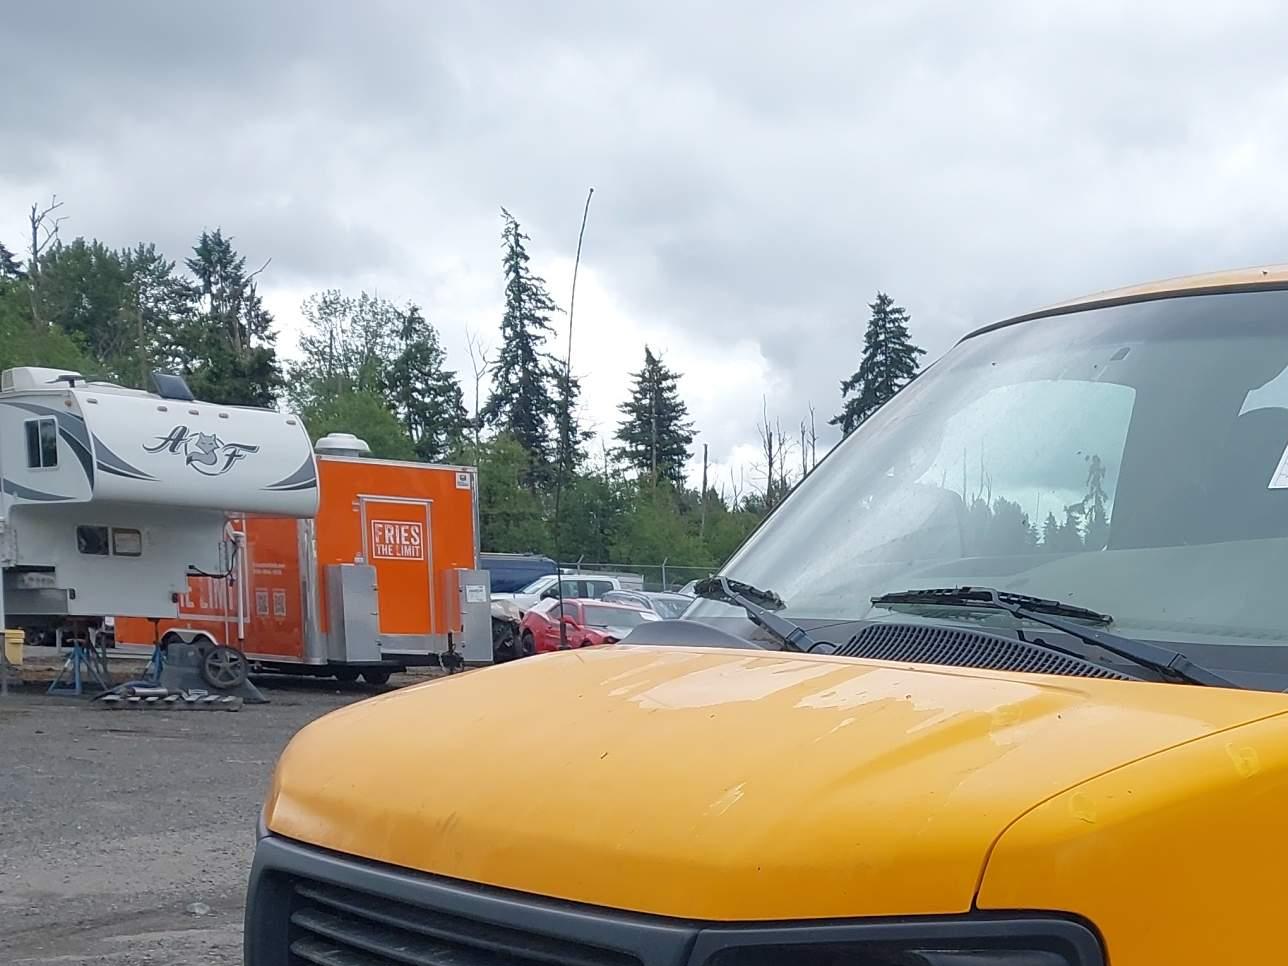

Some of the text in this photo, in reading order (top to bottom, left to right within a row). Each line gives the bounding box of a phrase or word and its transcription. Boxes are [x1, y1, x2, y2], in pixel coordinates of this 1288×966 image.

[374, 523, 420, 545] FRIES
[376, 543, 420, 557] THE LIMIT
